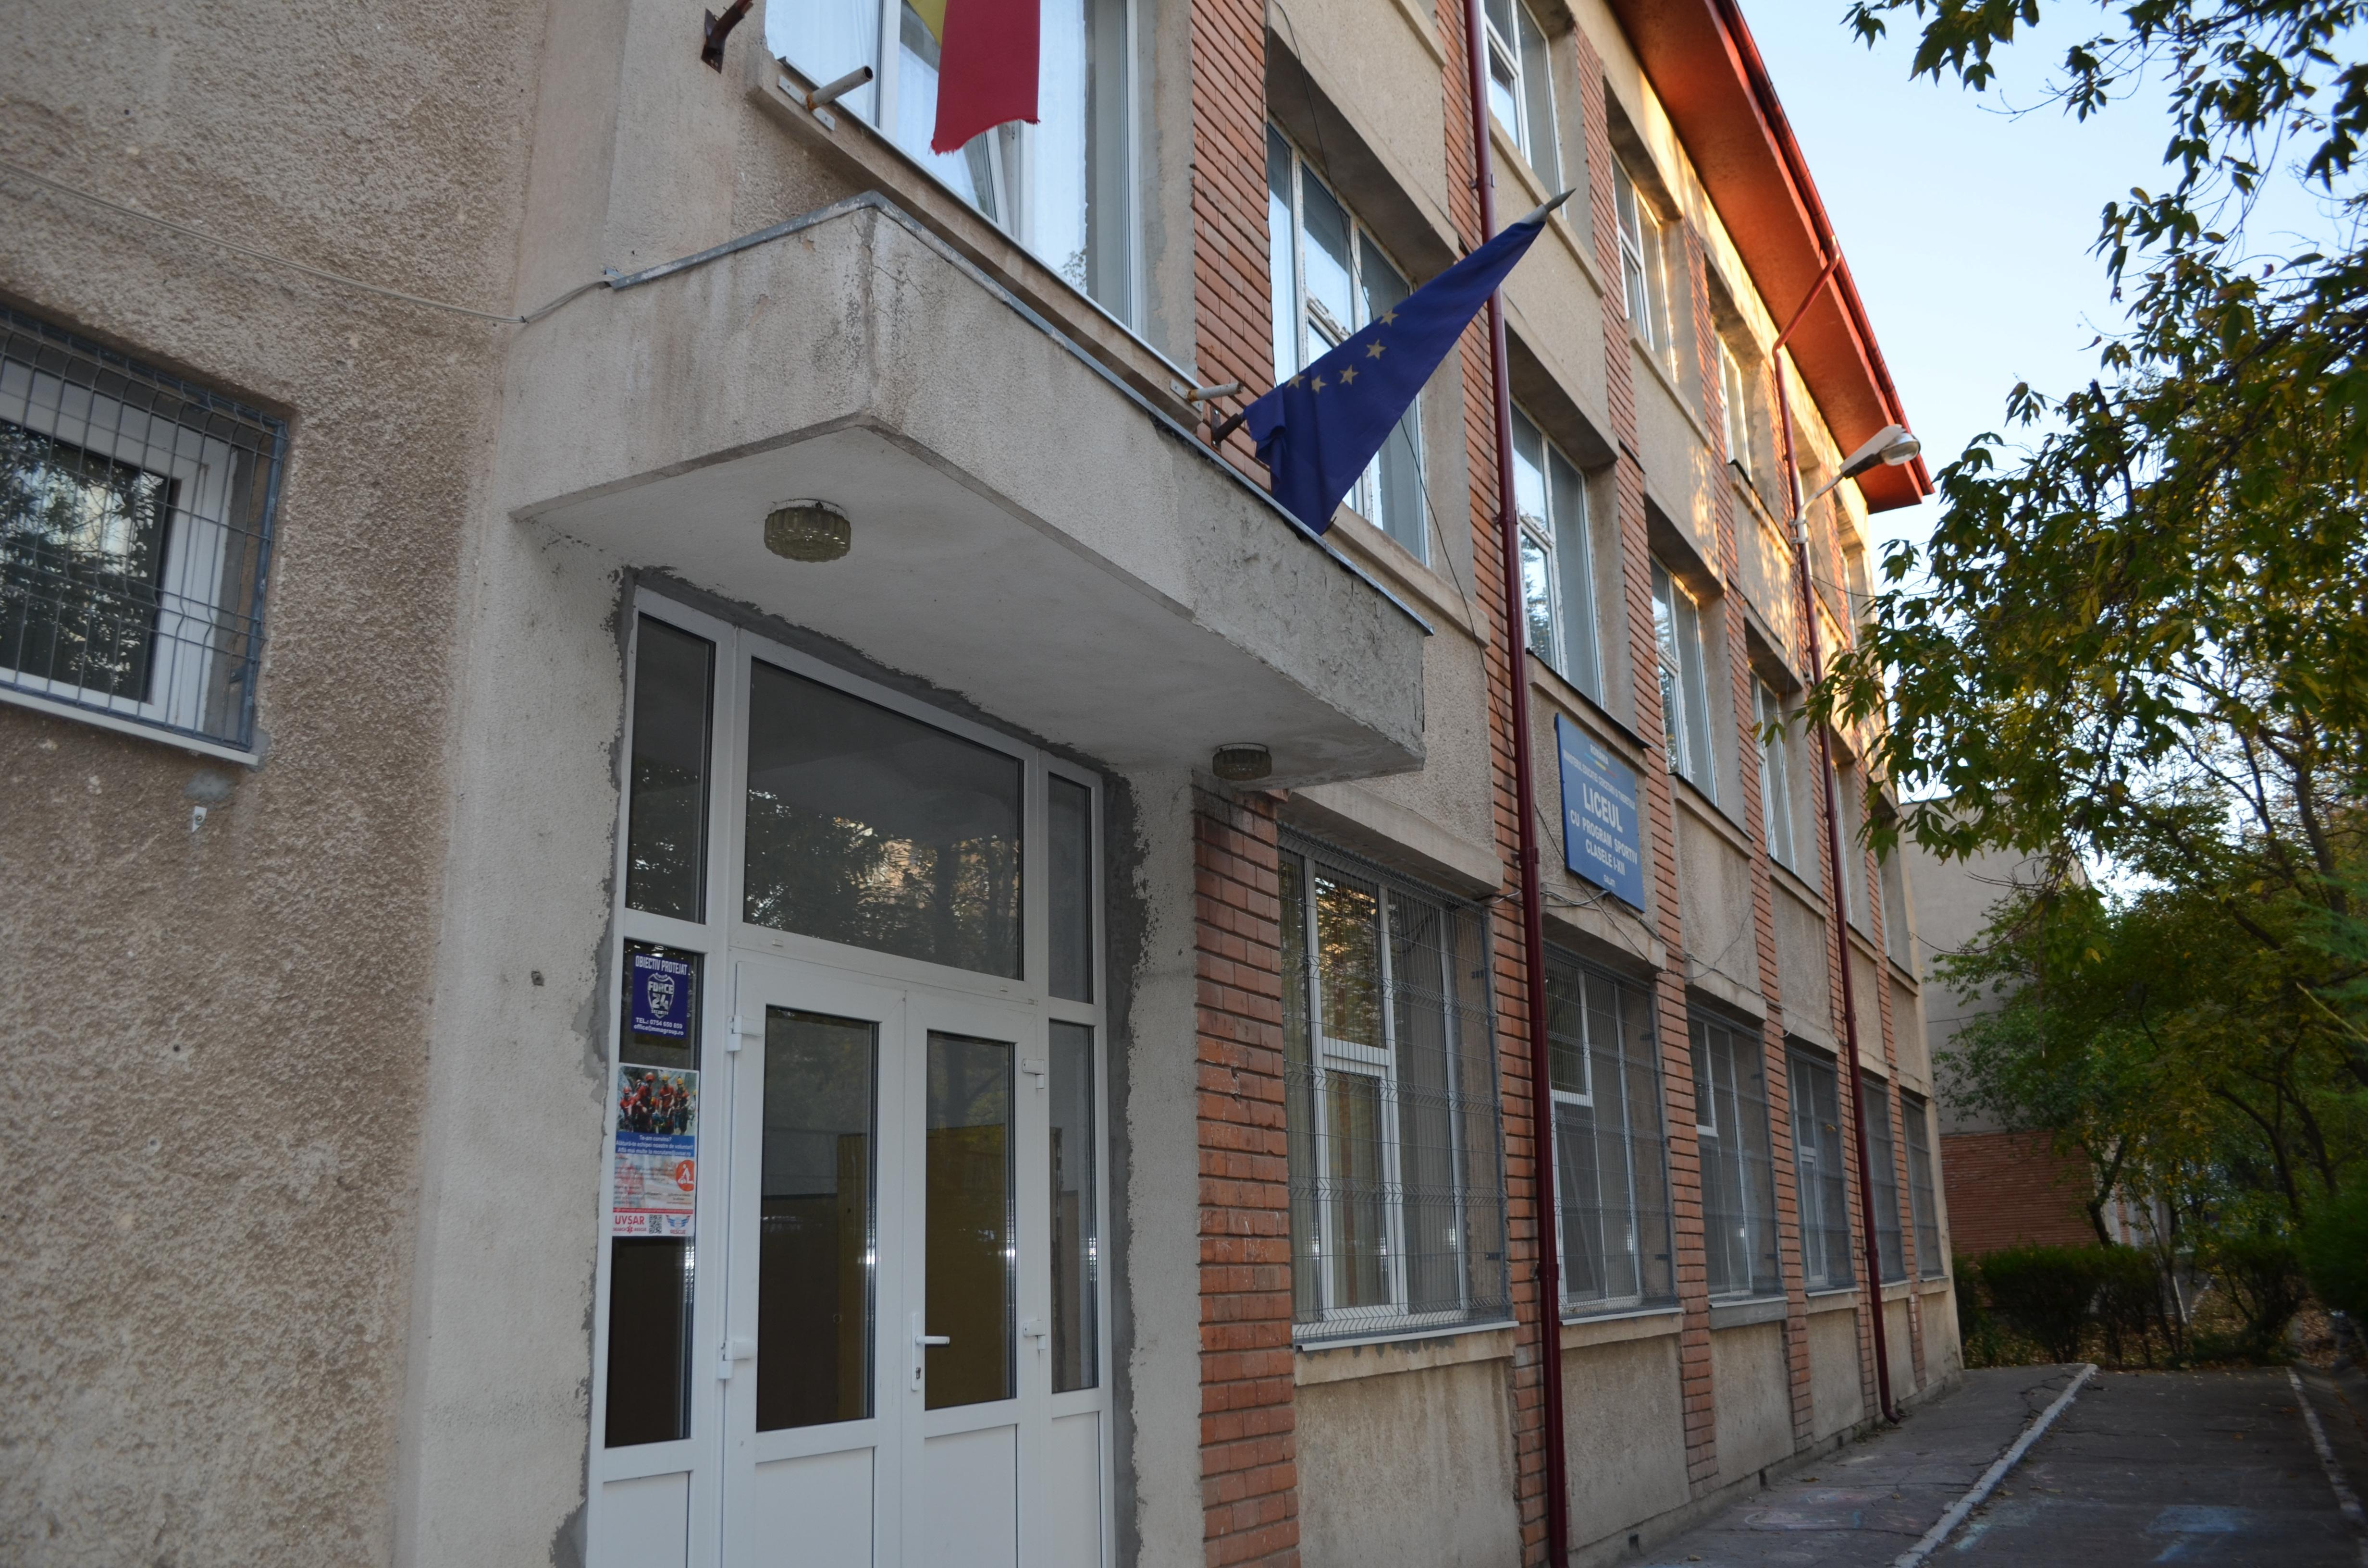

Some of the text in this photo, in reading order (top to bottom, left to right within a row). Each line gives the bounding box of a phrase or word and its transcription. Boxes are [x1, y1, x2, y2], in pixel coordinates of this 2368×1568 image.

[1582, 783, 1624, 833] LICEUL
[1570, 809, 1638, 865] CU PROGRAM SPORTIV
[1585, 838, 1626, 876] CLASELE I-XII
[635, 955, 661, 971] OBIECTIV
[661, 960, 688, 976] PROTEJAT
[648, 981, 674, 994] FORCE
[652, 993, 669, 1010] 24
[615, 1215, 645, 1225] UVSAR
